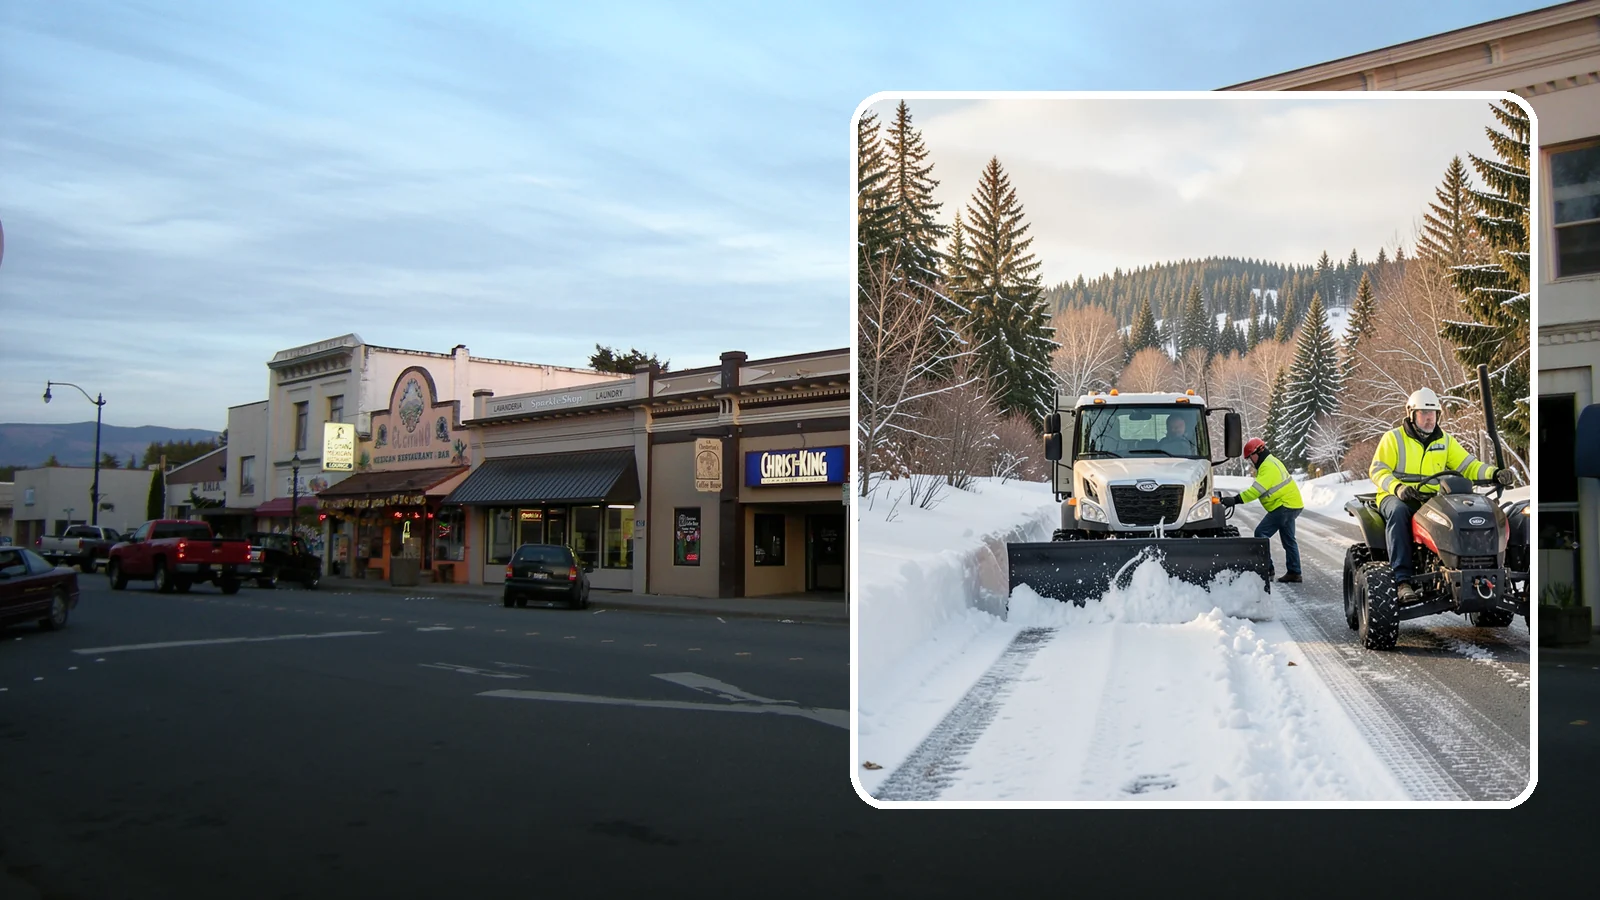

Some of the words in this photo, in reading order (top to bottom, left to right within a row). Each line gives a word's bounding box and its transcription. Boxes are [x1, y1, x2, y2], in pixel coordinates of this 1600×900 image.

[595, 389, 624, 400] LAUNDRY
[493, 402, 523, 412] LAVANDERIA
[530, 398, 560, 408] Sparkle
[561, 395, 582, 404] Shop
[373, 454, 396, 464] MEXICAN
[397, 451, 433, 462] RESTAURANT
[437, 450, 450, 459] BAR
[760, 452, 797, 477] CHRIST
[799, 450, 827, 476] KING
